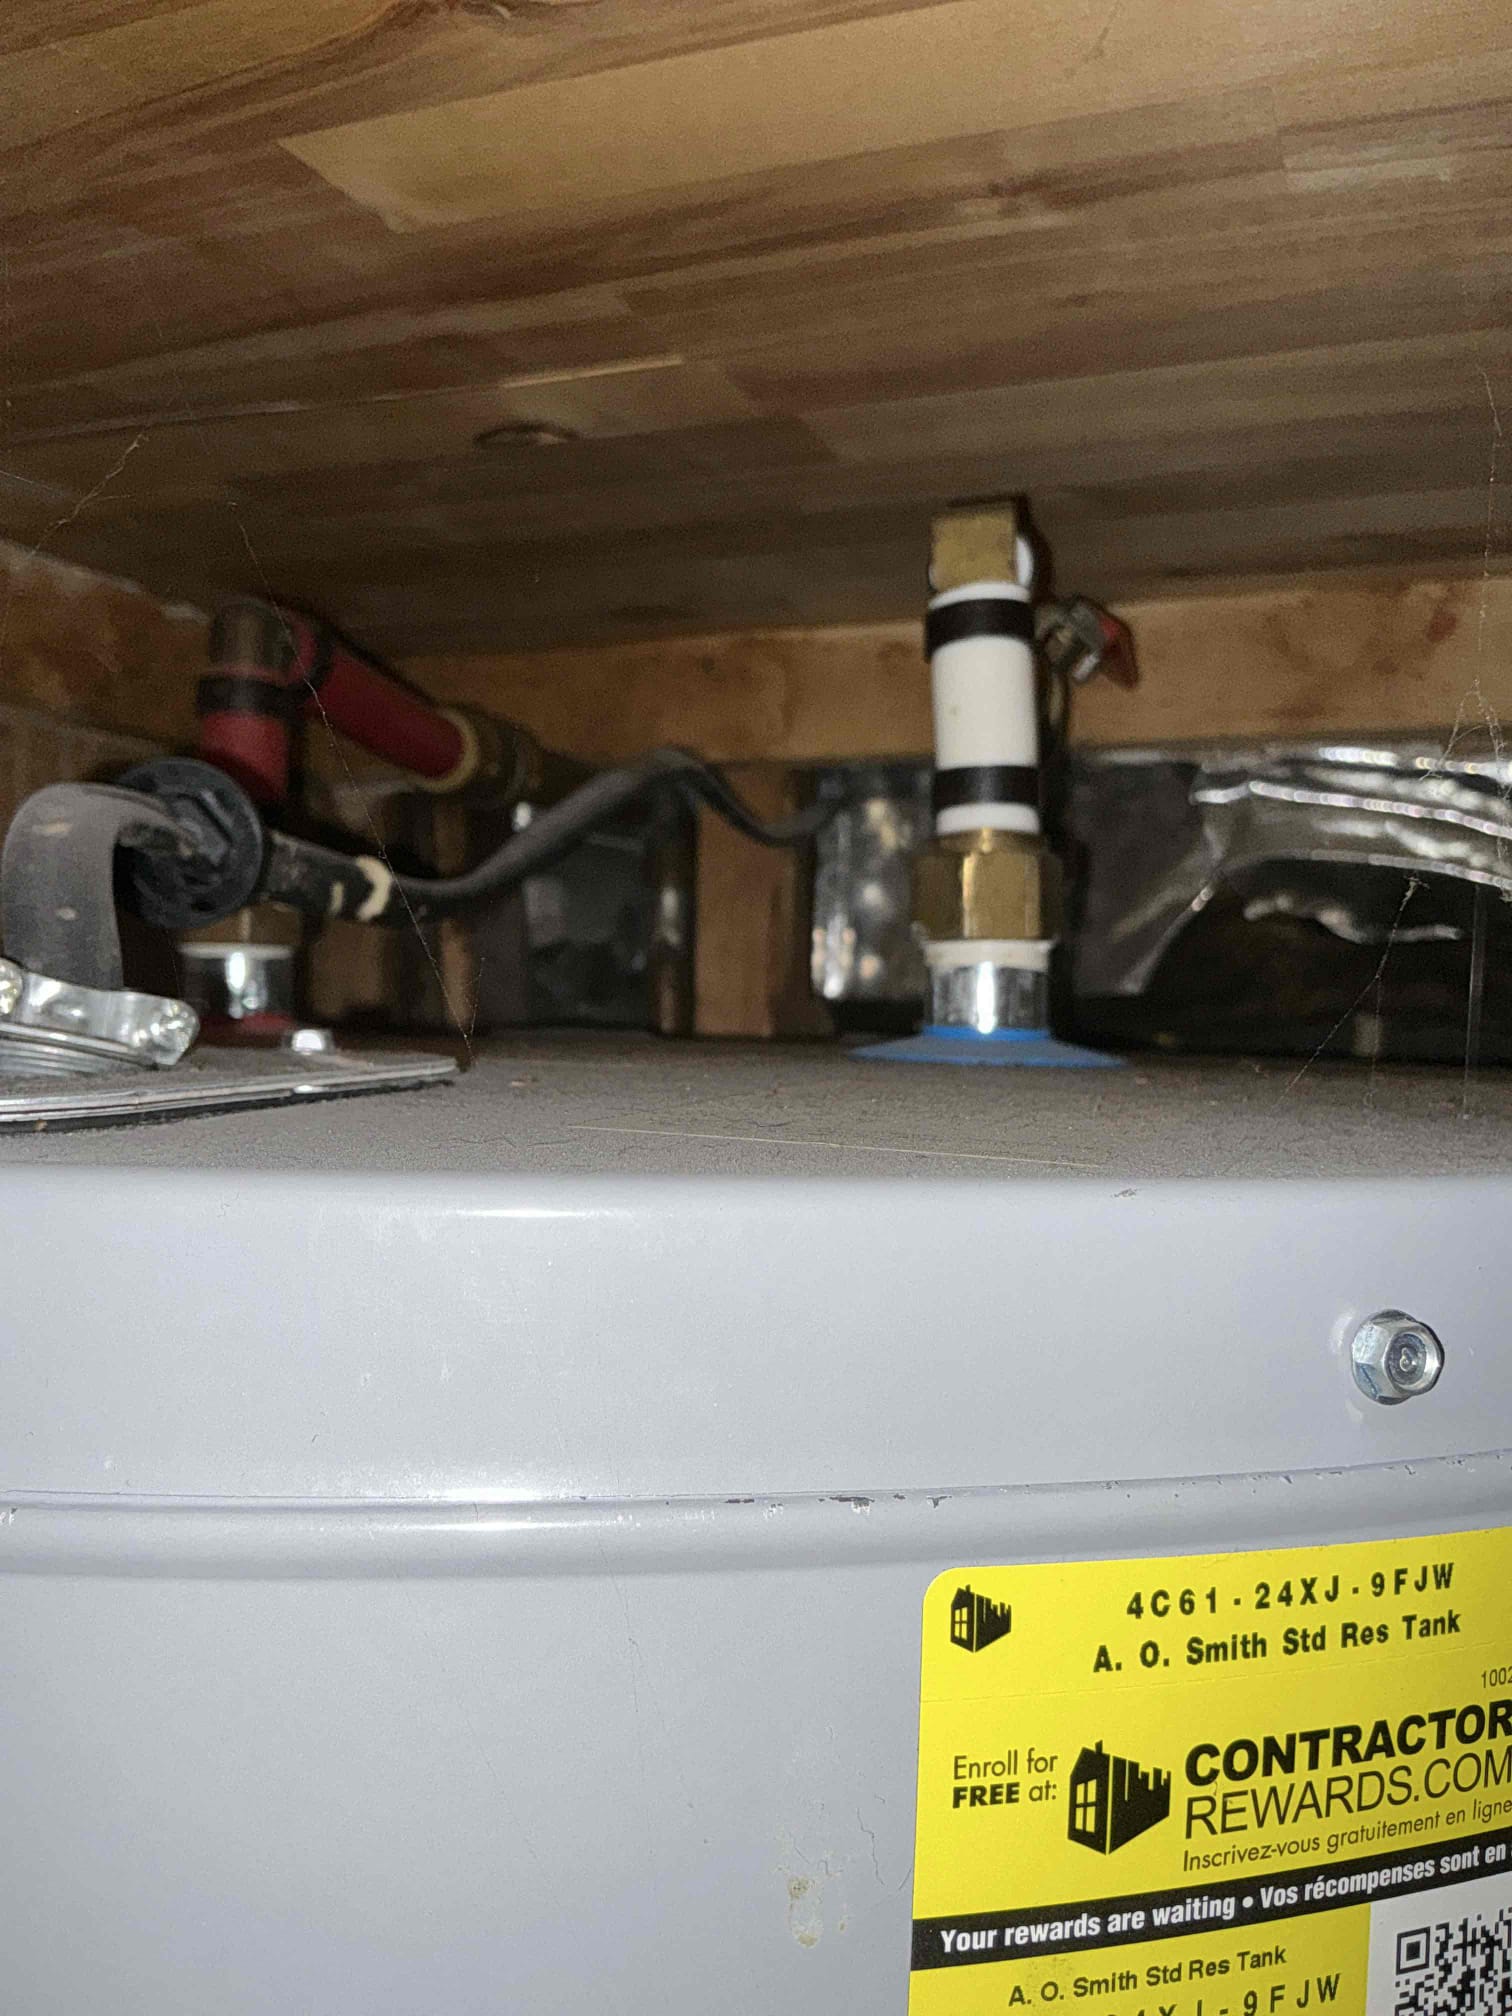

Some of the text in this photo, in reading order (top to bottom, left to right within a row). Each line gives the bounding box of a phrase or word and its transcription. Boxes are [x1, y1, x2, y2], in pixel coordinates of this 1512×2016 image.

[1093, 1609, 1461, 1673] A. O. Smith Std Res Tank
[954, 1747, 1058, 1780] Enroll for
[1185, 1699, 1512, 1786] CONTRACTOR
[952, 1780, 1057, 1809] FREE at:
[1185, 1744, 1512, 1840] REWARDS.COM
[1183, 1798, 1512, 1872] Inscrivez-vous gratuitement en ligne
[940, 1843, 1506, 1953] Your rewards are waiting Vos récompenses sont en
[1008, 1945, 1287, 2007] A. O. Smith Std Res Tank
